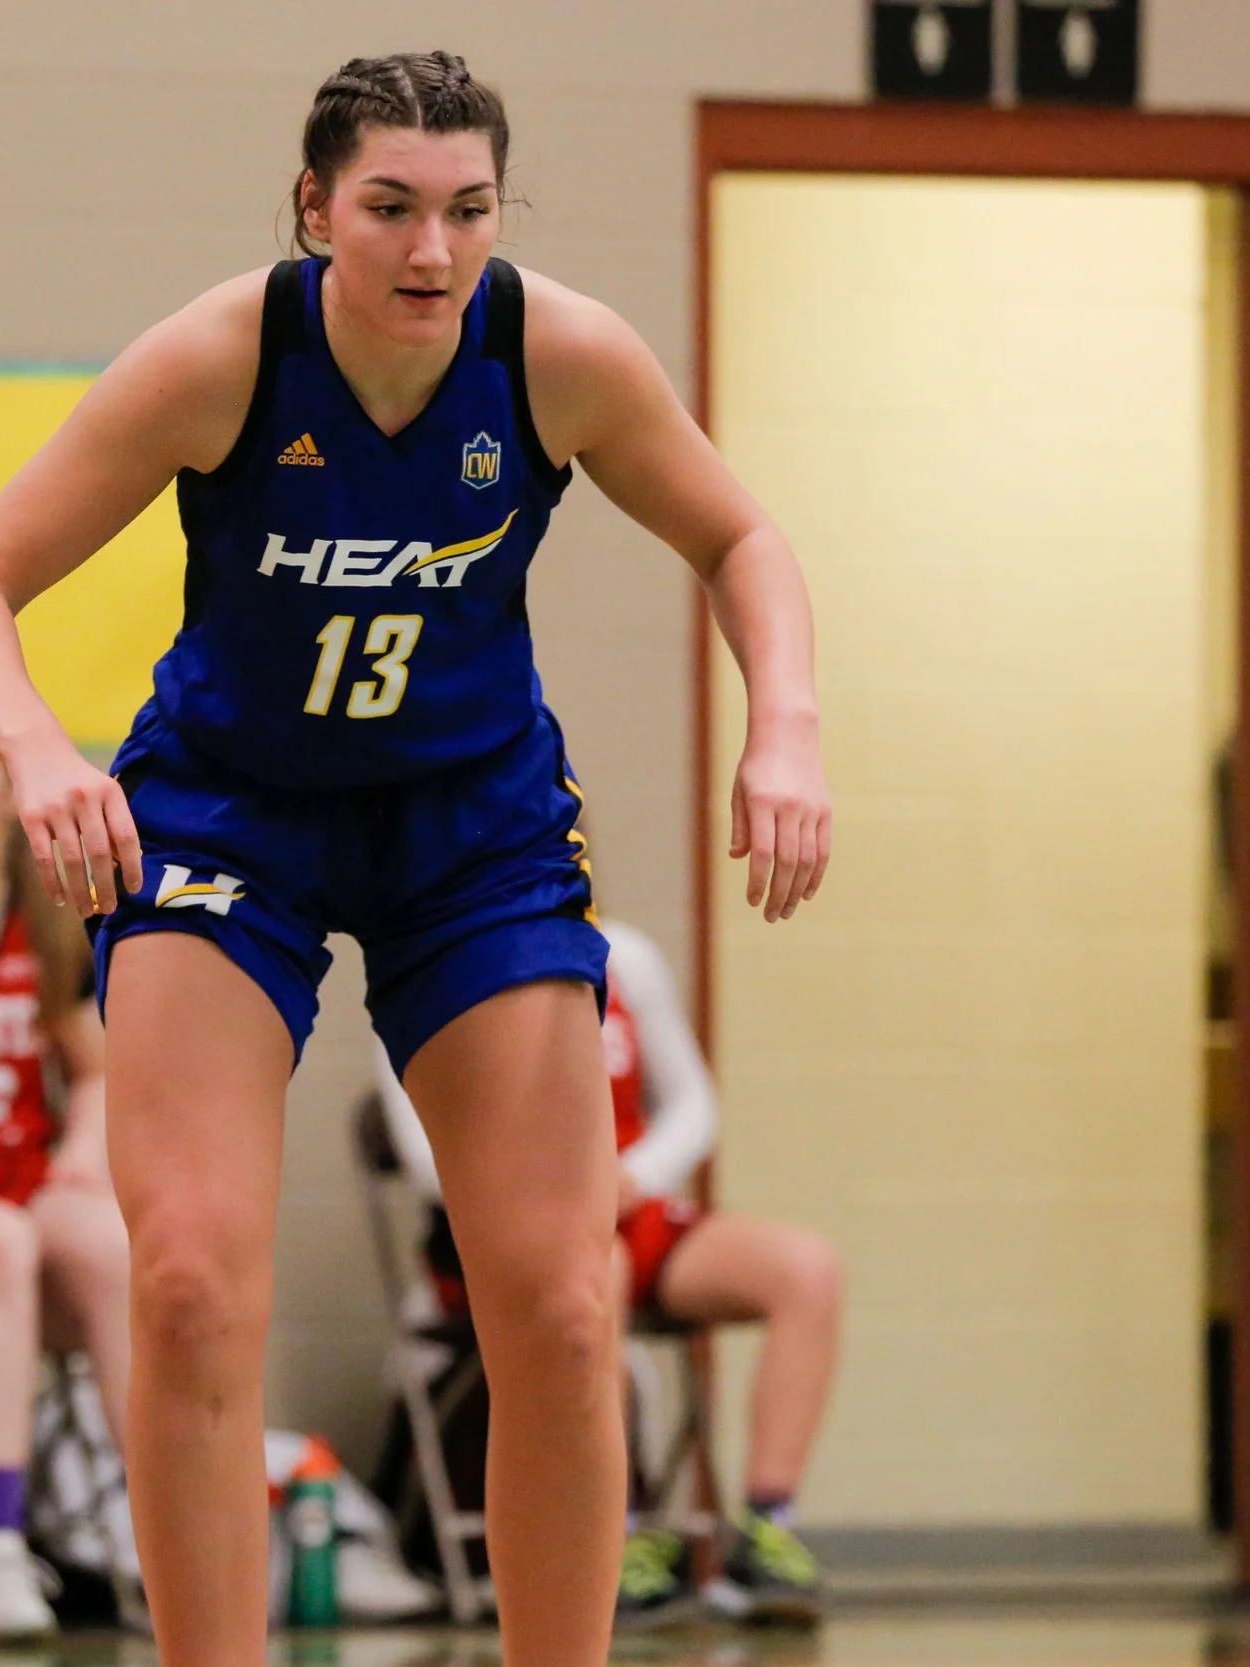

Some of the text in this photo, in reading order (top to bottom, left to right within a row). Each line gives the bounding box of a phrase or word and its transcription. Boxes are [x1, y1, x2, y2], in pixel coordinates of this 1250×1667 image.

[277, 452, 325, 467] adidas
[257, 511, 517, 588] HEAT
[304, 614, 424, 719] 13
